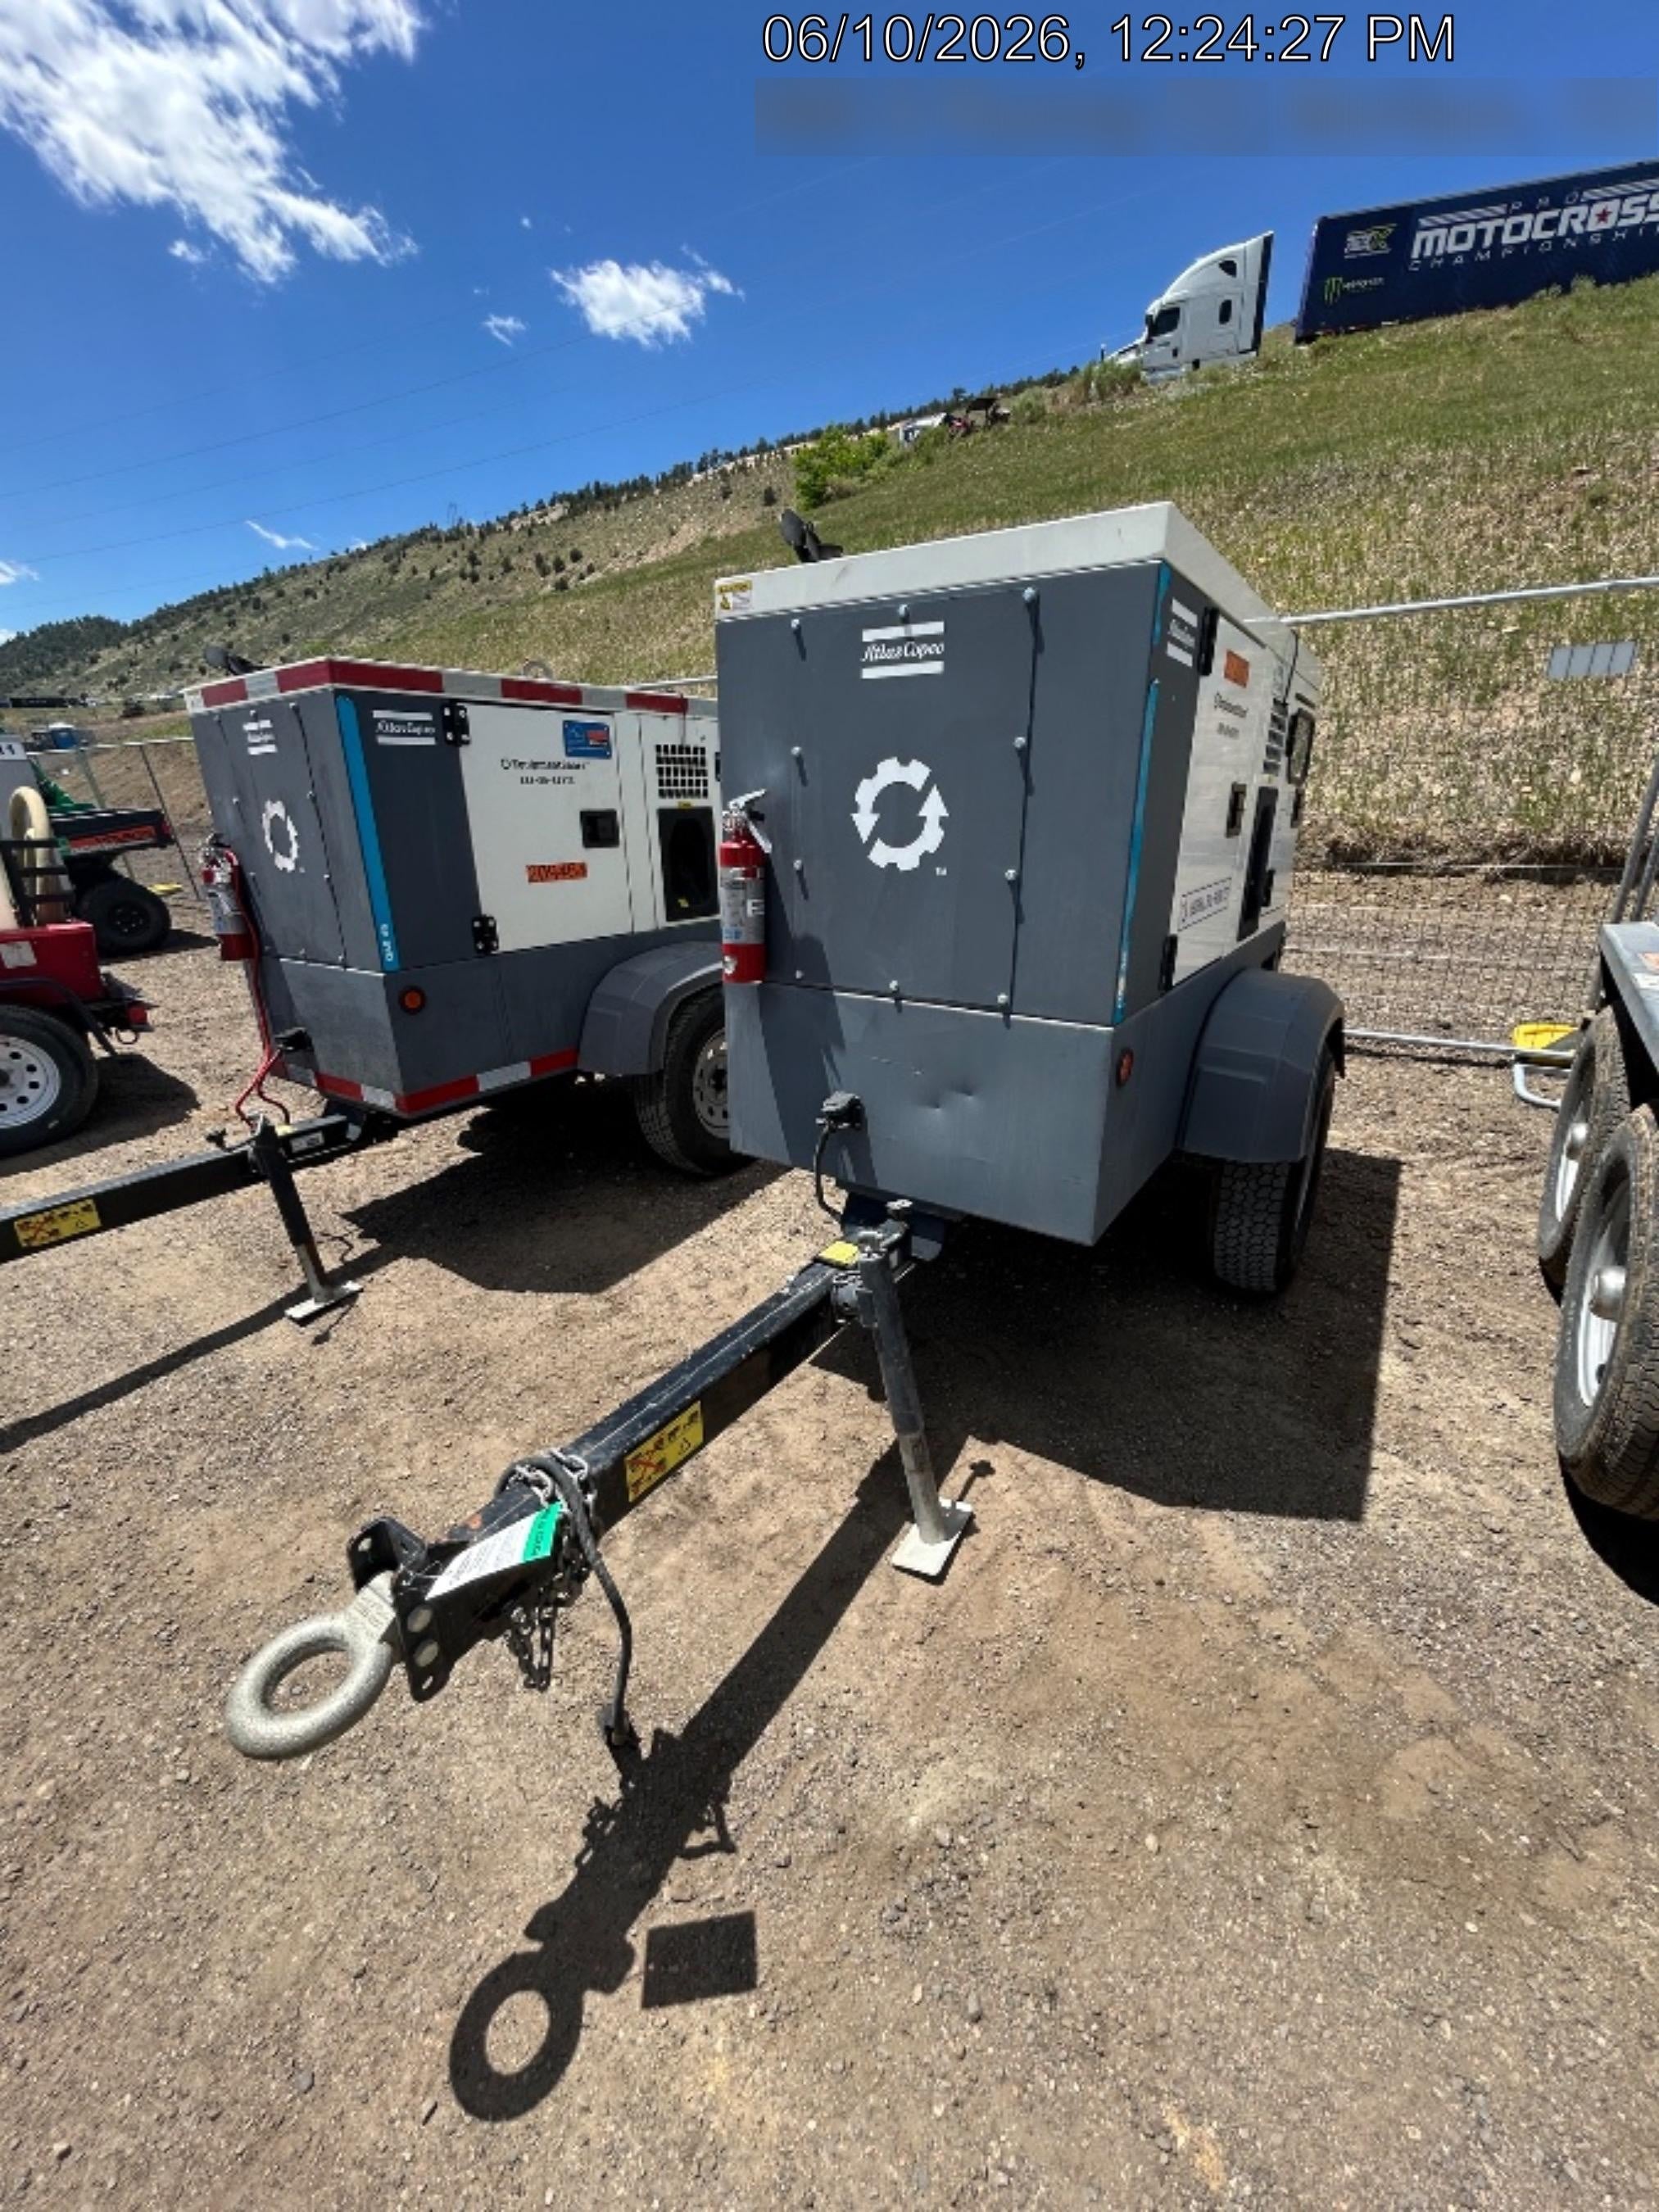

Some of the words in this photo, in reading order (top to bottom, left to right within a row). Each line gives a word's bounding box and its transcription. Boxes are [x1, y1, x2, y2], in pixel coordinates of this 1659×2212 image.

[1509, 191, 1579, 214] PRO
[1408, 224, 1659, 271] CHAMPIONSHI
[860, 643, 902, 662] Atlas
[904, 641, 945, 660] Copco
